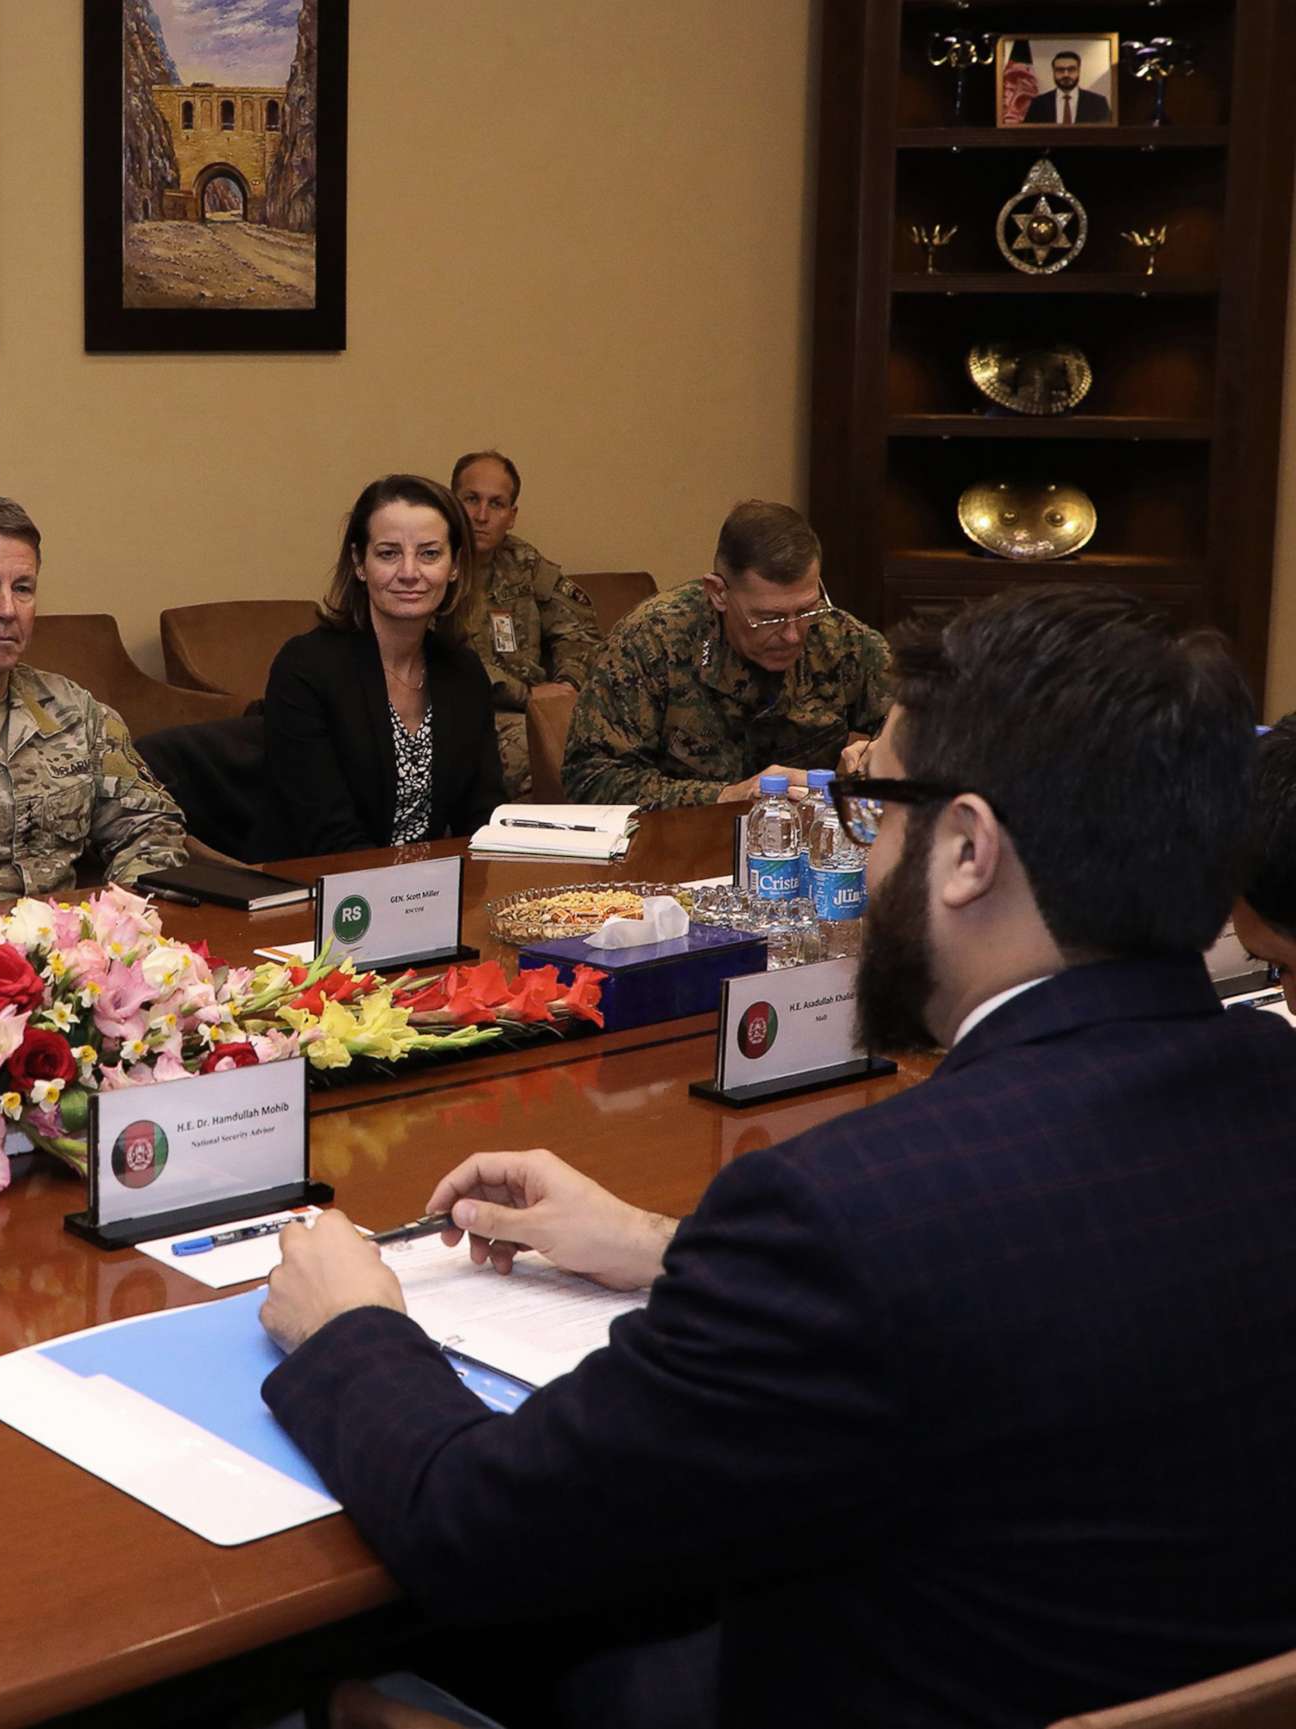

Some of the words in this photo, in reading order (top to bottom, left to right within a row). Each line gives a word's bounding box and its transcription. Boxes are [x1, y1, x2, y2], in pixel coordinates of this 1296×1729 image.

[760, 875, 800, 891] Crista
[406, 892, 421, 901] Scott
[422, 889, 440, 898] Miller
[342, 906, 362, 922] RS
[789, 1002, 801, 1012] H.E.
[803, 995, 834, 1009] Asadullah
[177, 1121, 194, 1133] H.E.
[197, 1118, 210, 1129] Dr.
[212, 1108, 259, 1126] Hamdullah
[261, 1101, 289, 1116] Mohib
[191, 1135, 220, 1148] National
[221, 1131, 247, 1144] Security
[250, 1125, 275, 1137] Advisor
